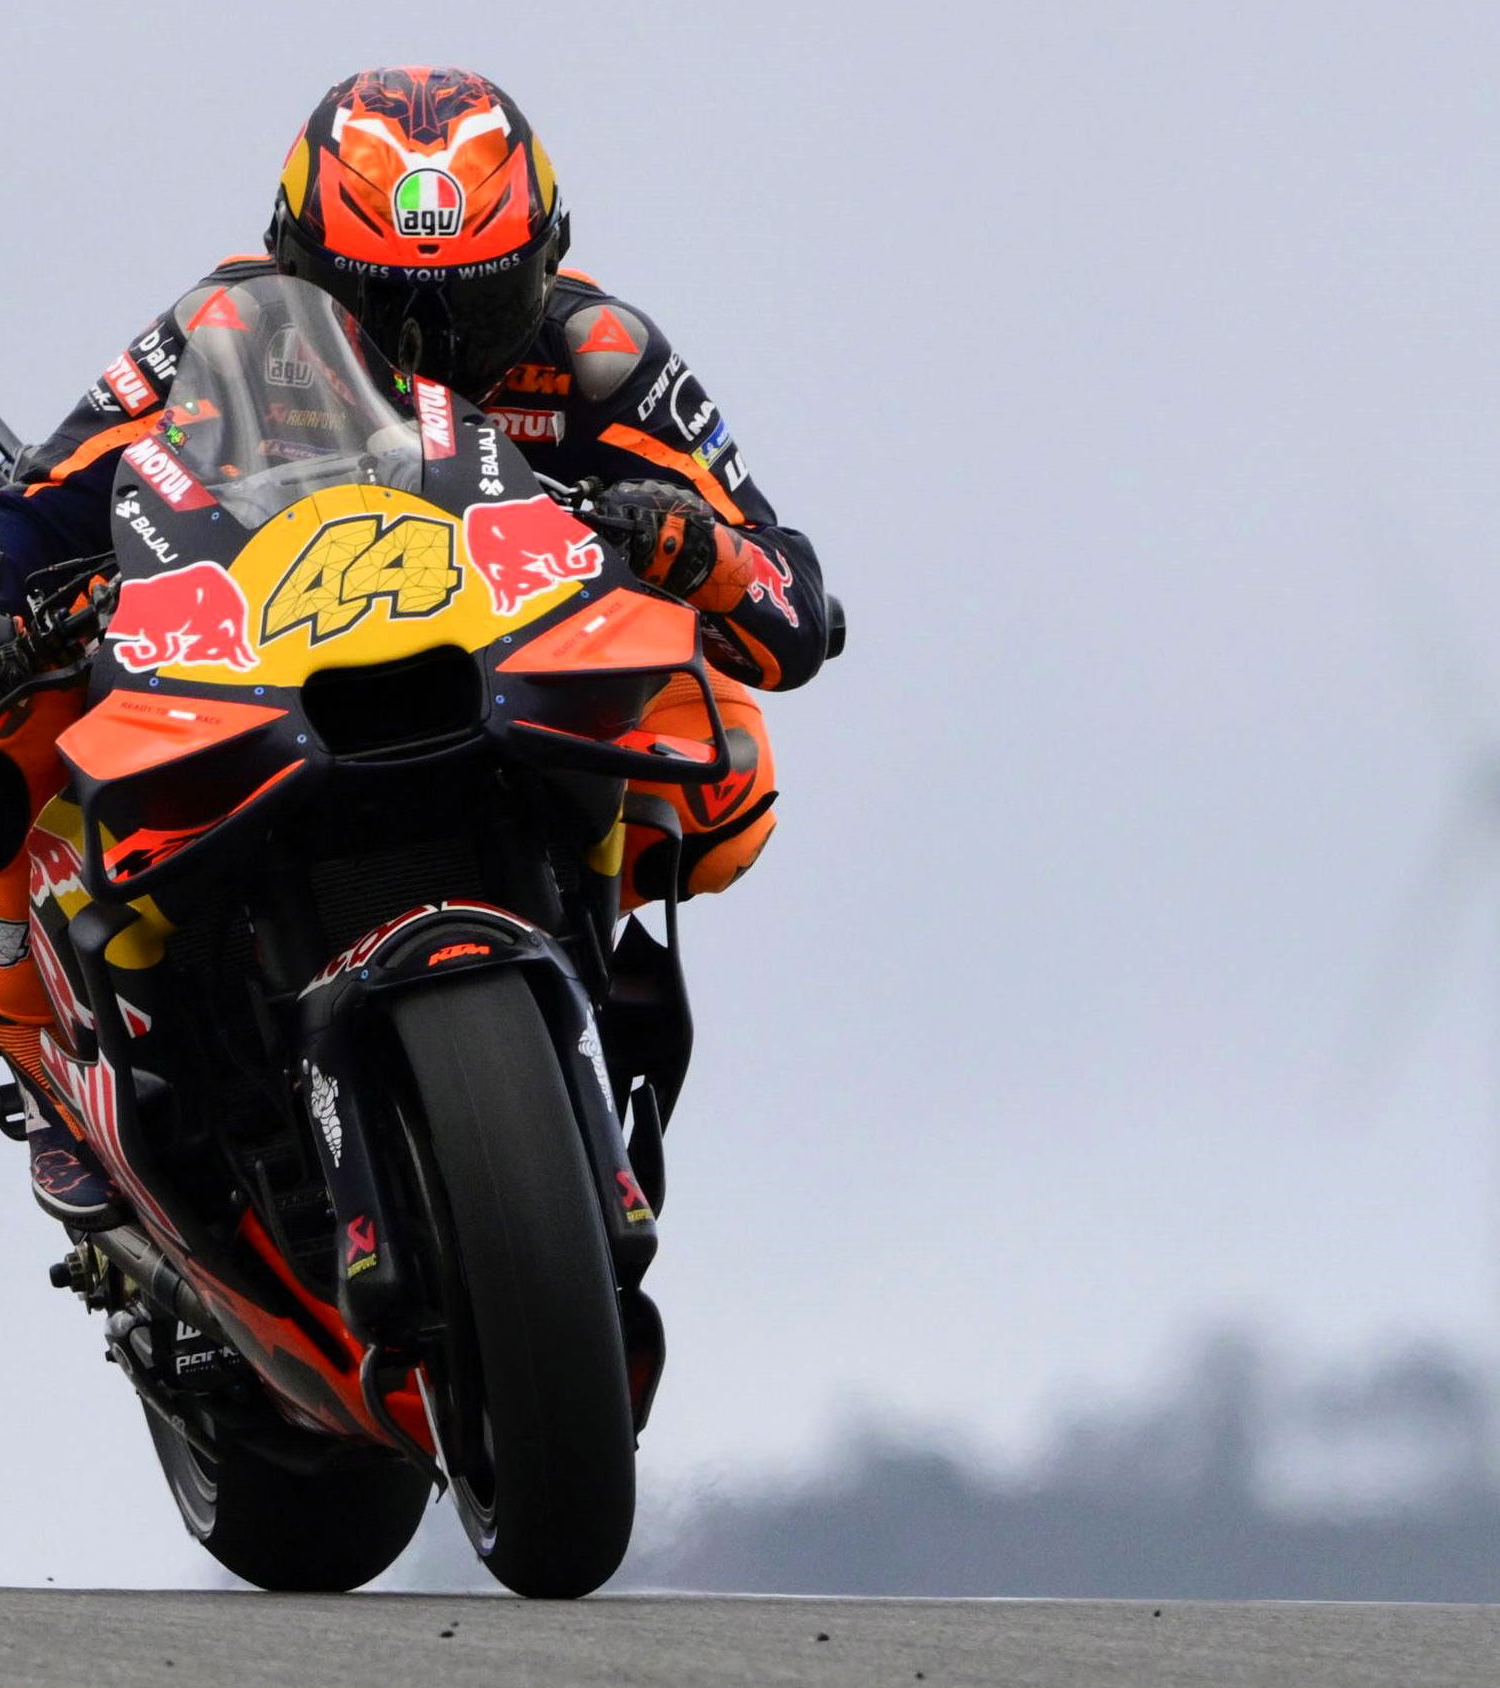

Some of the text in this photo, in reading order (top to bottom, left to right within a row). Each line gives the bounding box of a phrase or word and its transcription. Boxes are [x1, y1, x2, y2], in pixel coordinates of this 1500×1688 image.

[403, 209, 454, 236] agv
[334, 254, 522, 282] GIVES YOU WINGS
[417, 382, 451, 448] MOTUL
[123, 438, 193, 503] MOTUL
[478, 427, 499, 476] BAJAJ
[130, 516, 179, 564] BAJAJ
[259, 513, 464, 647] 44
[428, 943, 490, 967] KTM
